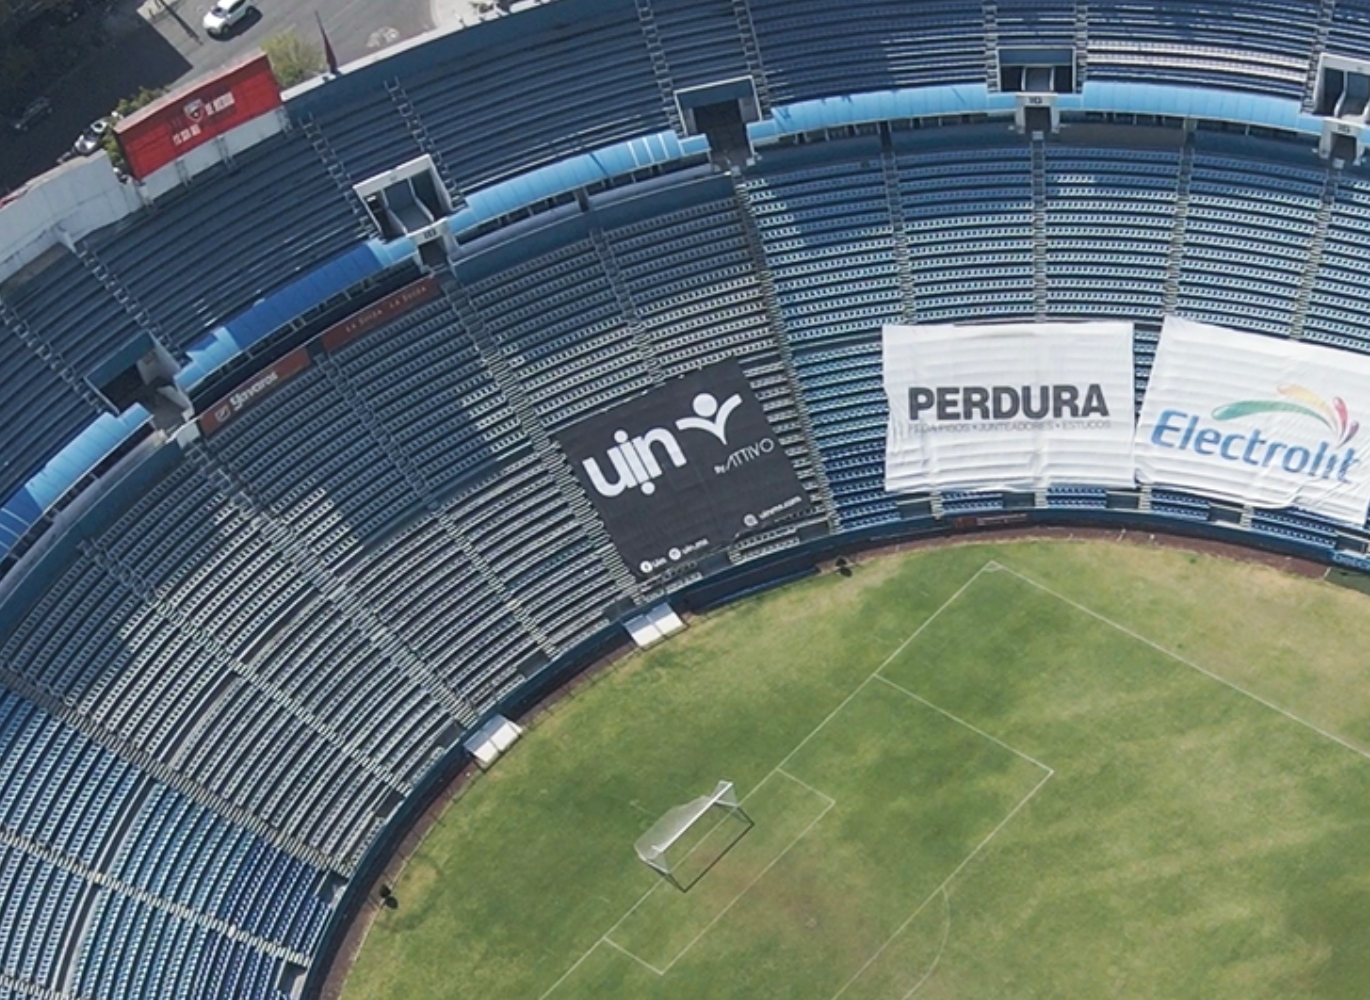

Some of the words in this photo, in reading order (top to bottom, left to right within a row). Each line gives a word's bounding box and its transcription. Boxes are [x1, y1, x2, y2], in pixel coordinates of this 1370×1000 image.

[908, 383, 1110, 421] PERDURA
[1061, 419, 1112, 430] ESTUCOS
[726, 437, 775, 471] ATTIVO
[1150, 408, 1360, 484] Electrolit
